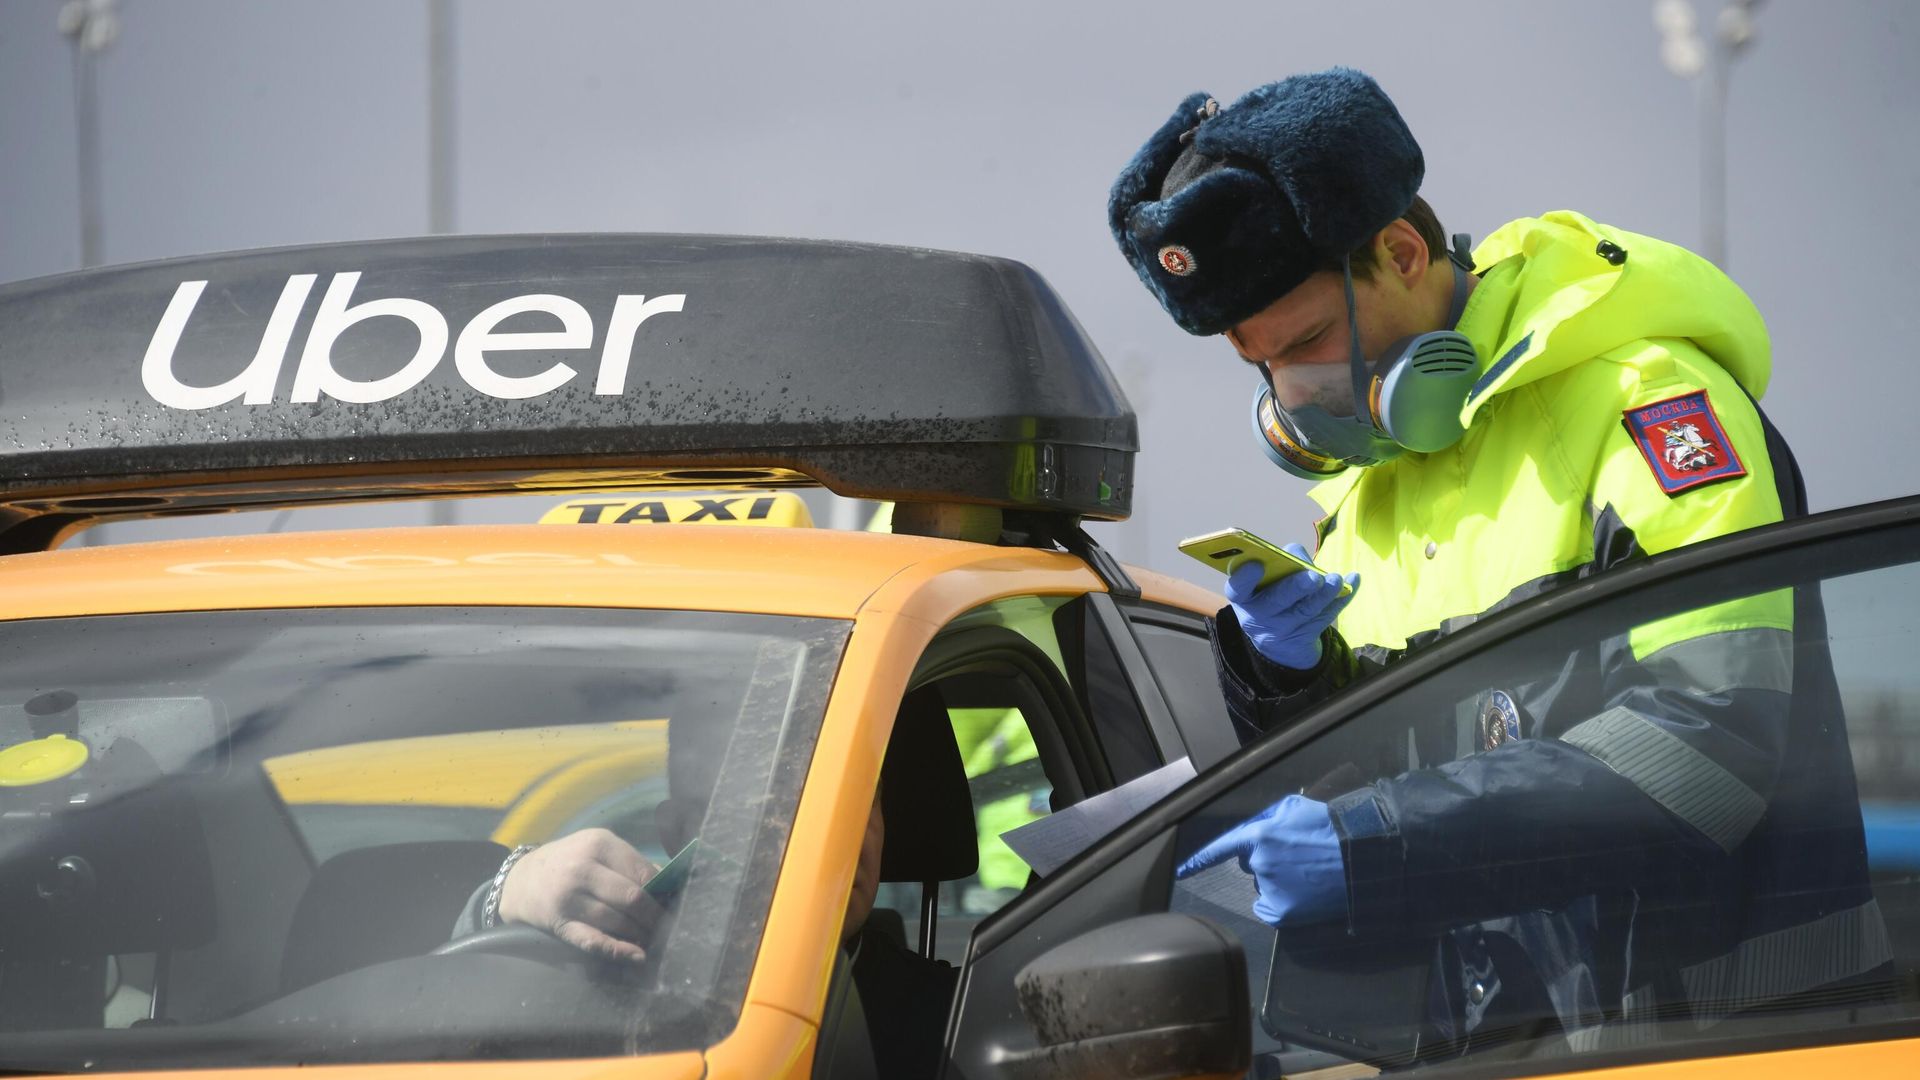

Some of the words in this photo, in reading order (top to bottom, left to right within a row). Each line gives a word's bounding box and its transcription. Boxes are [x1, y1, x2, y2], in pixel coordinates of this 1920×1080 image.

[141, 271, 686, 410] Uber
[1640, 399, 1698, 423] МОСКВА
[566, 497, 776, 524] TAXI
